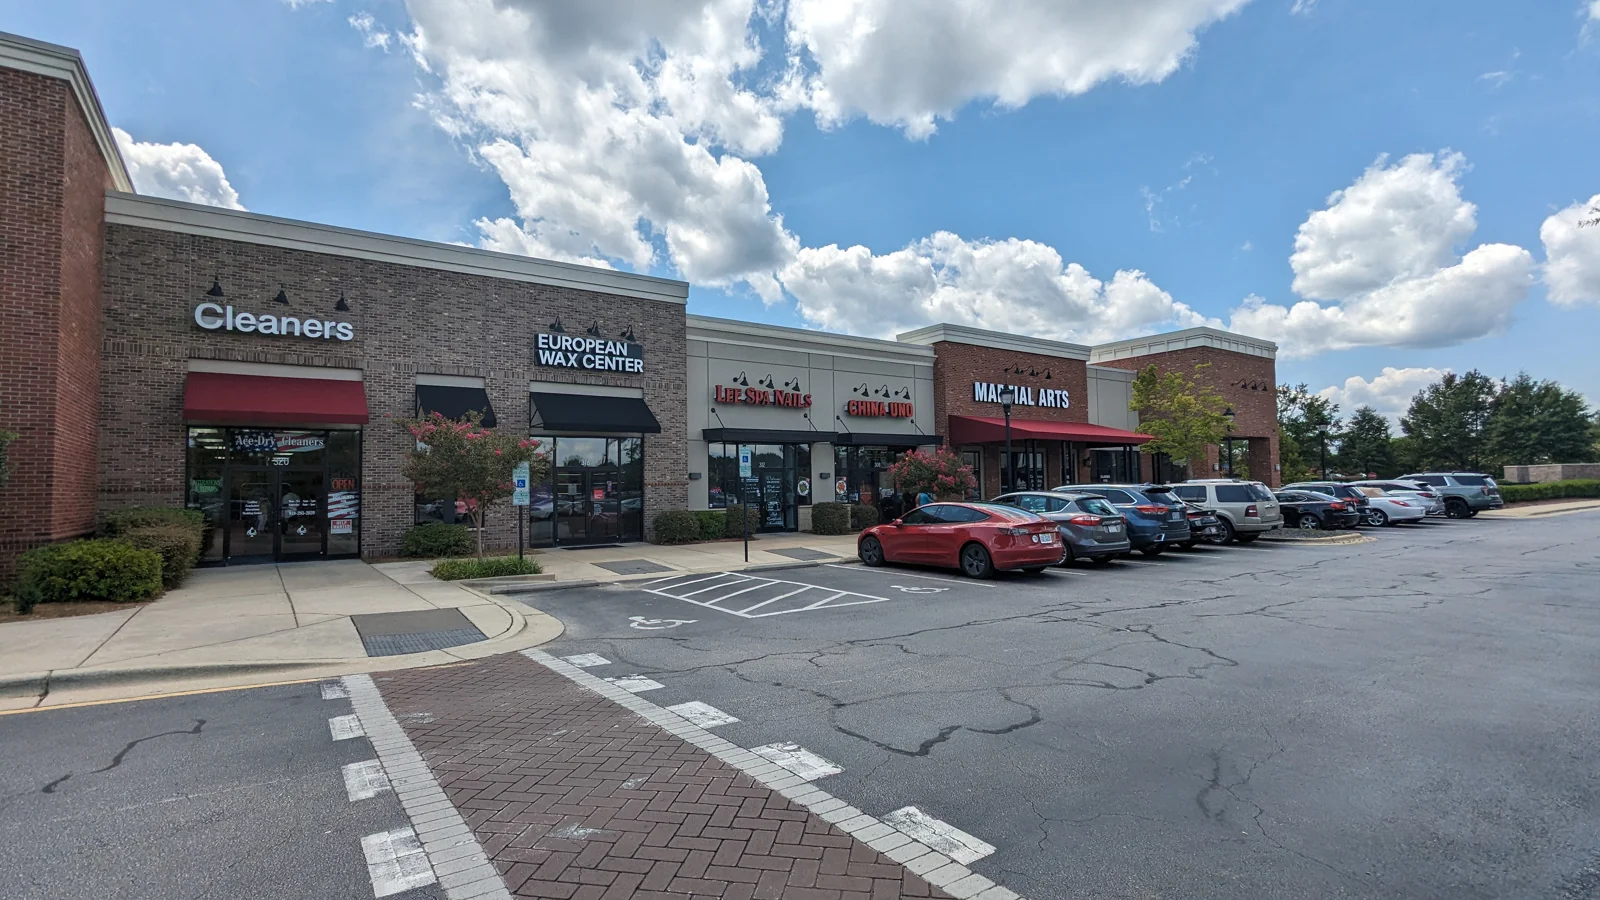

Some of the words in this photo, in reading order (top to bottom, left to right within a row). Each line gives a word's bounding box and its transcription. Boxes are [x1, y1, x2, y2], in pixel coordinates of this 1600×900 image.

[194, 302, 354, 341] Cleaners
[538, 333, 628, 356] EUROPEAN
[538, 349, 579, 368] WAX
[582, 354, 644, 373] CENTER
[973, 381, 1035, 406] MAIAL
[1038, 388, 1070, 409] ARTS
[848, 400, 887, 416] CHINA
[888, 402, 914, 418] UNO
[281, 436, 324, 446] Cleaners
[332, 479, 355, 490] OPEN
